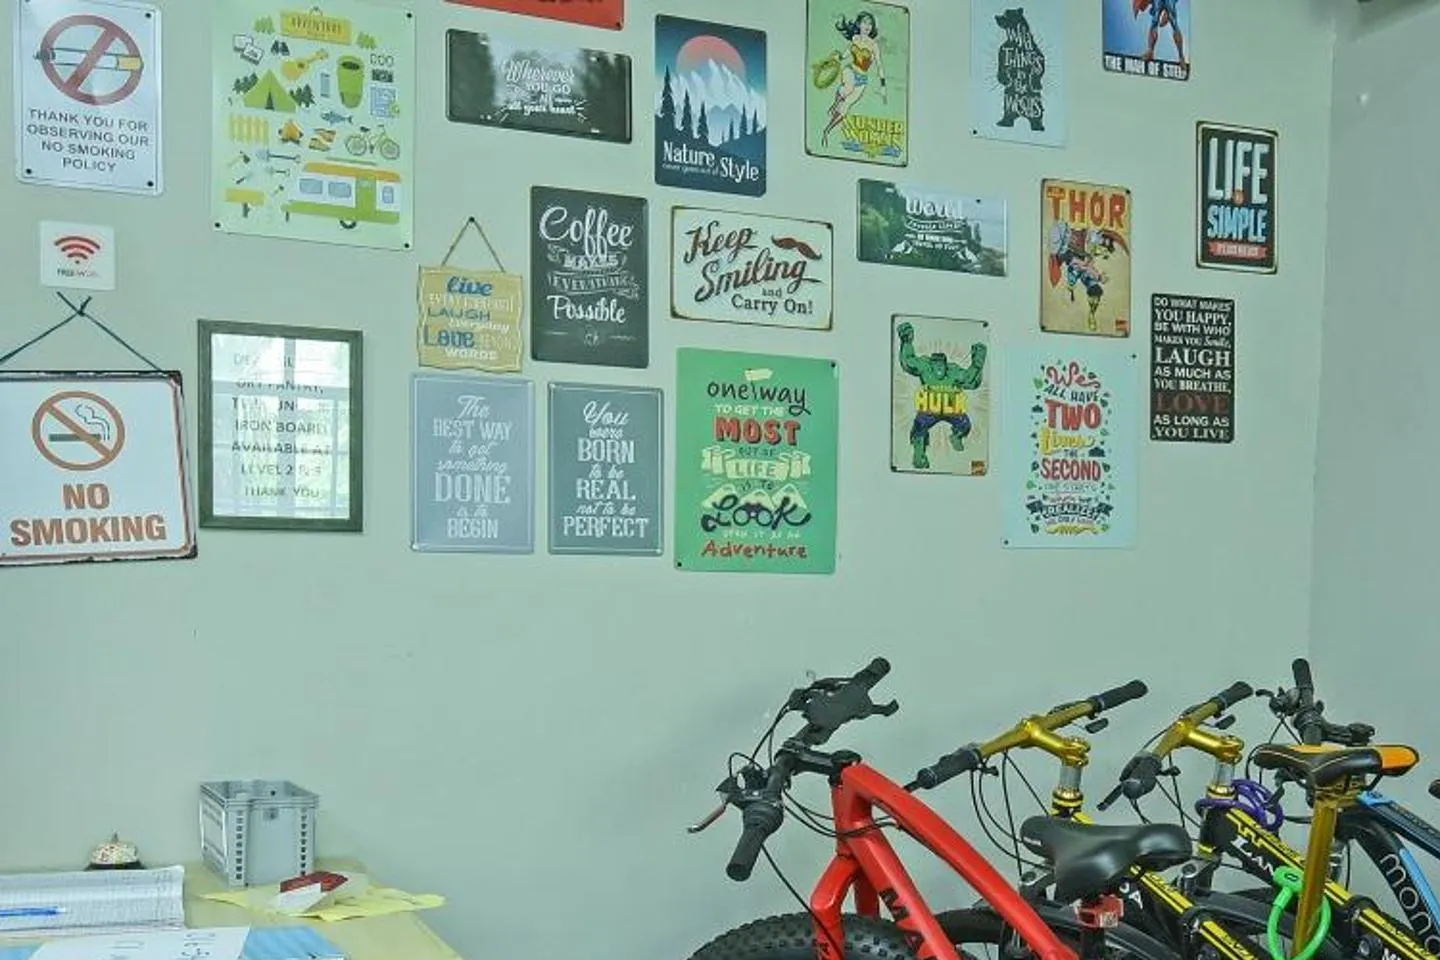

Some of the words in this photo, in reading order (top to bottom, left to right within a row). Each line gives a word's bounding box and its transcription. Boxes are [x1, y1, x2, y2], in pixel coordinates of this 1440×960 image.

[30, 109, 79, 125] THANK
[84, 115, 114, 128] YOU
[118, 118, 148, 132] FOR
[27, 124, 114, 143] OBSERVING
[118, 134, 149, 147] OUR
[41, 141, 64, 152] NO
[68, 143, 136, 160] SMOKING
[663, 140, 715, 167] Nature
[720, 156, 759, 183] Style
[62, 157, 116, 172] POLICY
[1208, 137, 1270, 204] LIFE
[1047, 186, 1126, 229] THOR
[540, 204, 634, 262] Coffee
[1207, 205, 1268, 243] SIMPLE
[683, 220, 758, 264] Keep
[694, 247, 823, 302] Smiling
[731, 293, 778, 315] Carry
[784, 299, 813, 314] On!
[762, 287, 782, 298] and
[427, 307, 491, 321] LAUGH
[546, 294, 627, 323] Possible
[1154, 308, 1184, 321] YOU
[1186, 311, 1232, 326] HAPPY,
[1171, 323, 1201, 334] WITH
[1203, 325, 1231, 336] WHO
[1155, 347, 1232, 367] LAUGH
[1154, 366, 1171, 377] AS
[1174, 368, 1211, 379] MUCH
[1215, 370, 1232, 380] AS
[1154, 378, 1177, 389] YOU
[707, 381, 749, 400] one
[1045, 384, 1066, 399] ALL
[457, 395, 490, 419] The
[583, 400, 631, 427] You
[914, 391, 967, 414] HULK
[1156, 392, 1229, 414] LOVE
[1045, 398, 1102, 431] TWO
[1154, 414, 1171, 425] AS
[1174, 415, 1209, 427] LONG
[1213, 416, 1230, 427] AS
[432, 417, 475, 439] BEST
[480, 420, 513, 441] WAY
[713, 416, 801, 446] MOST
[1154, 427, 1189, 438] YOU
[1193, 427, 1230, 439] LIVE
[577, 438, 635, 464] BORN
[1041, 458, 1102, 482] SECOND
[62, 483, 111, 510] NO
[434, 471, 512, 504] DONE
[576, 478, 636, 500] REAL
[9, 515, 167, 547] SMOKING
[447, 518, 499, 539] BEGIN
[563, 515, 650, 538] PERFECT
[701, 540, 807, 558] Adventure
